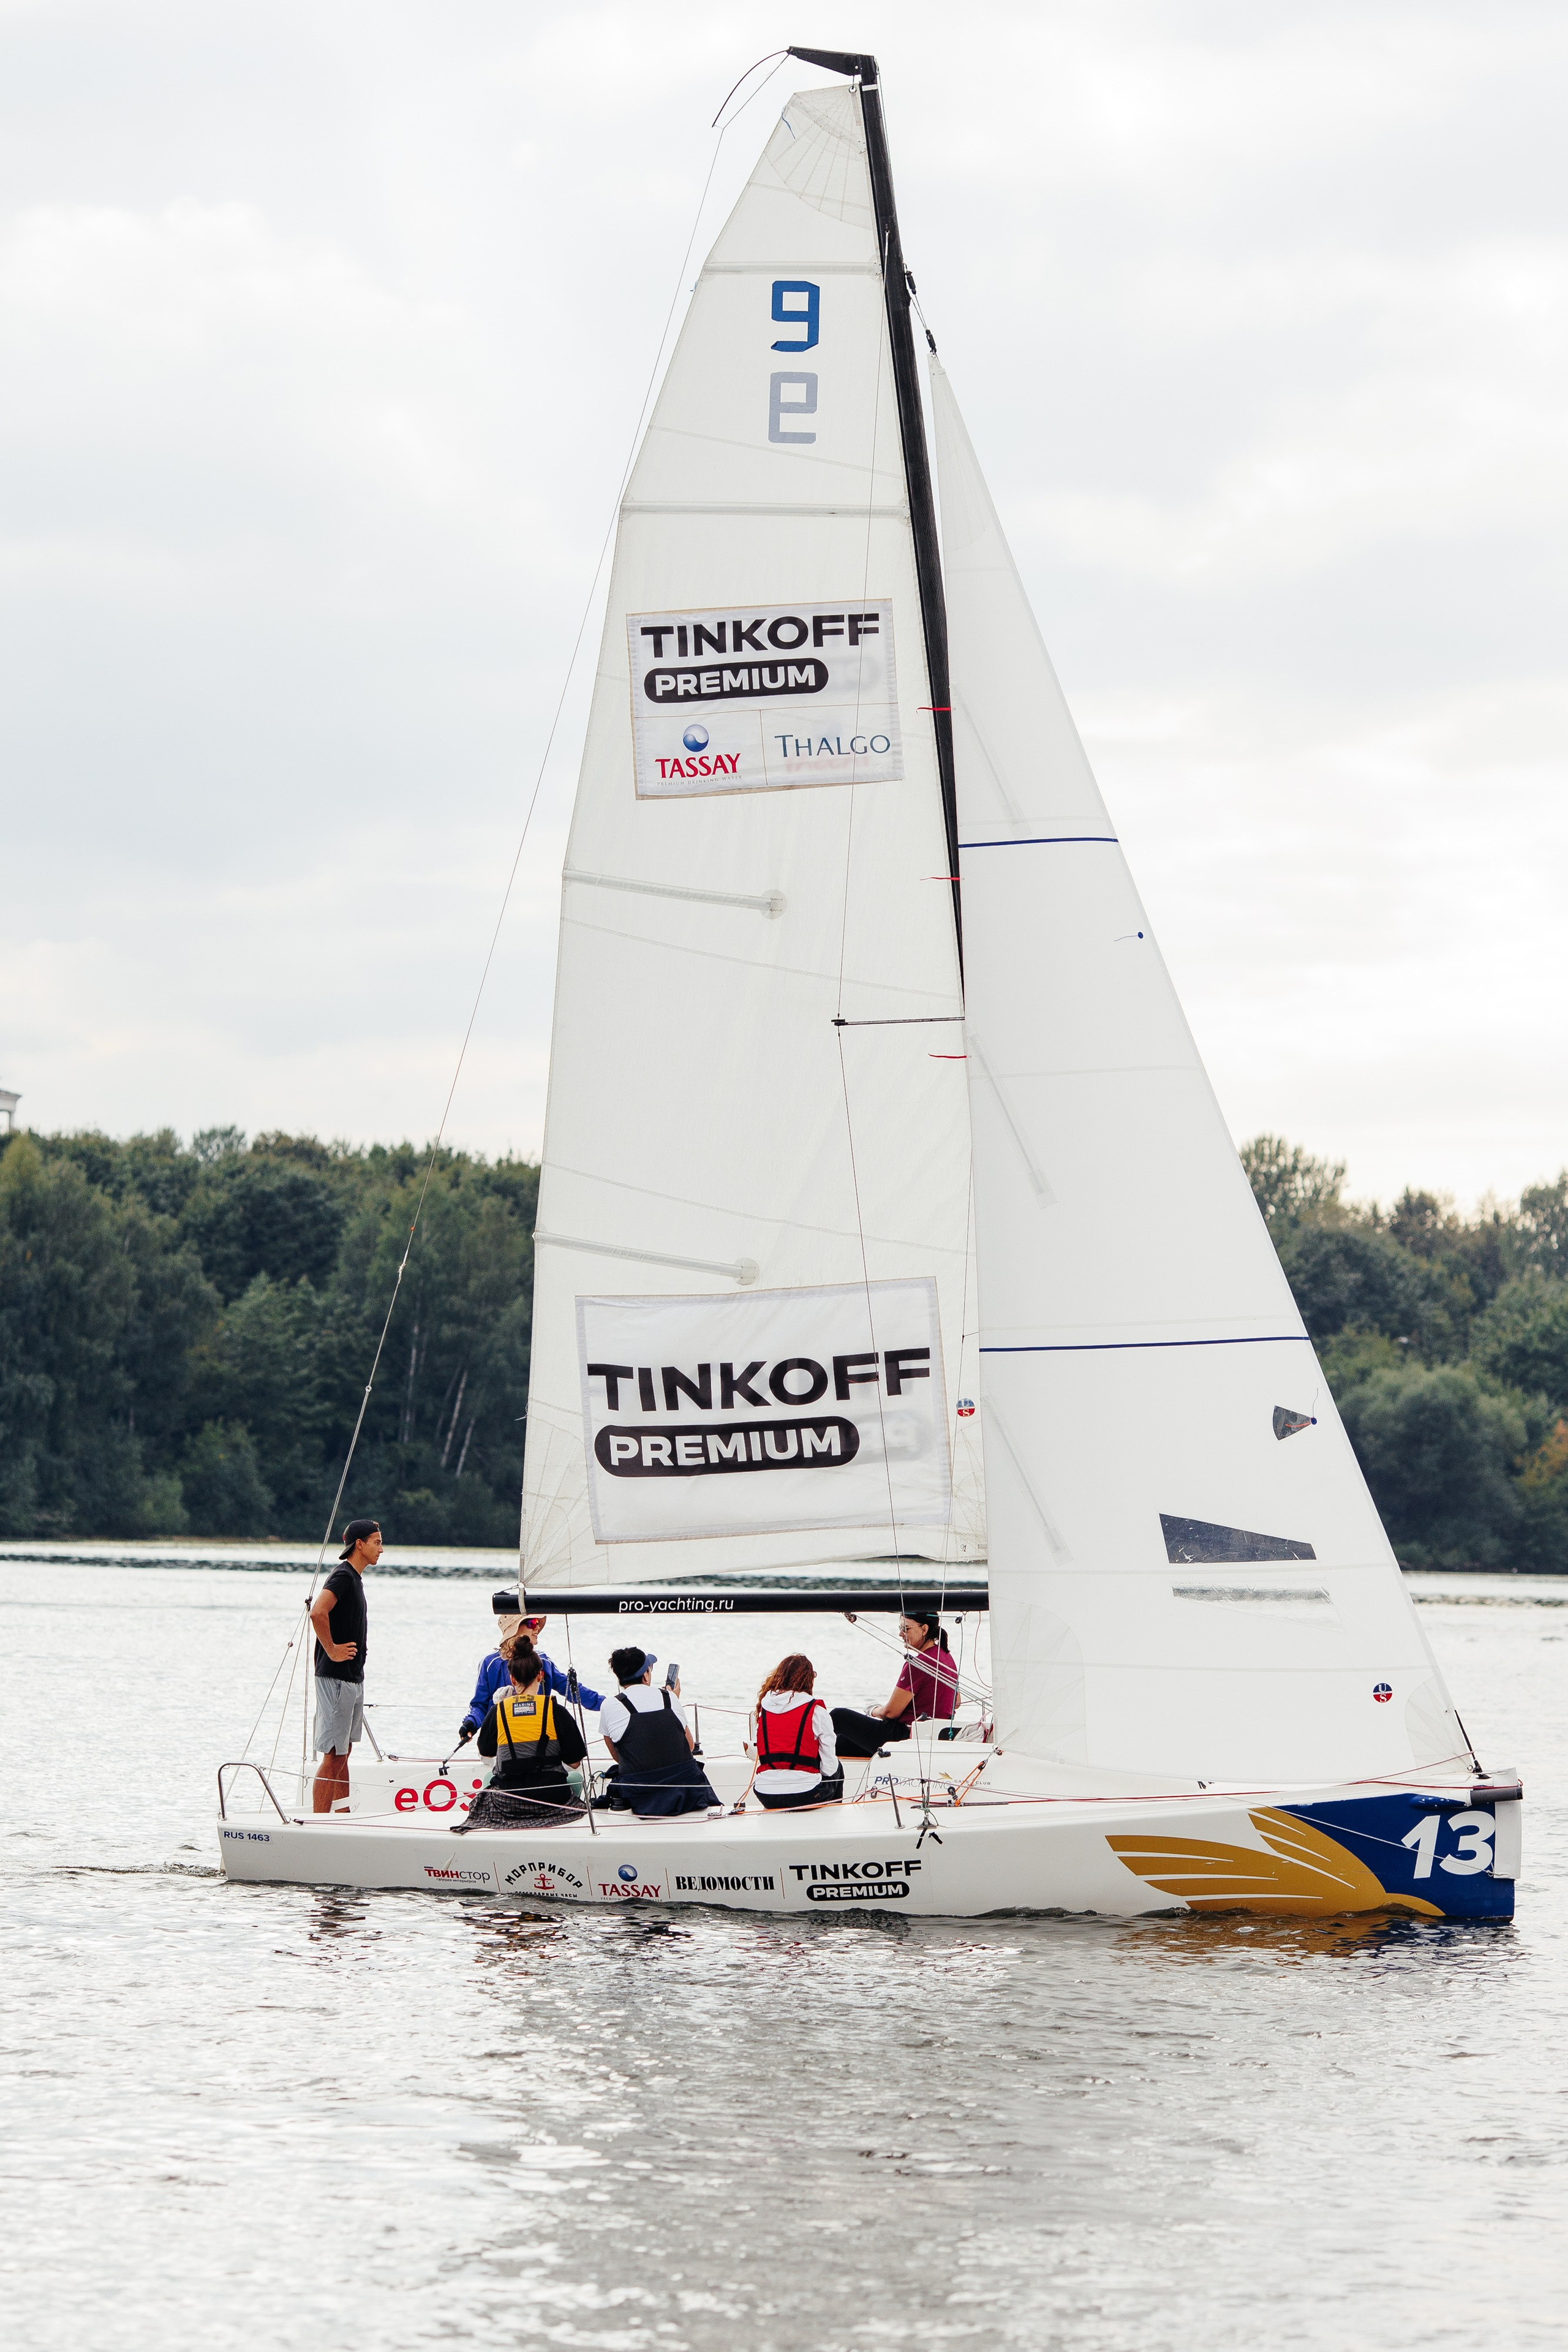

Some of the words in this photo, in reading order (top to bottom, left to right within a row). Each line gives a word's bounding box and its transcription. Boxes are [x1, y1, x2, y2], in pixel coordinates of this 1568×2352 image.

[771, 281, 820, 352] 9
[640, 612, 880, 658] TINKOFF
[655, 665, 816, 696] PREMIUM
[655, 753, 741, 778] TASSAY
[587, 1347, 930, 1411] TINKOFF
[609, 1425, 842, 1466] PREMIUM
[619, 1597, 734, 1613] pro-yachting.ru
[224, 1831, 244, 1839] RUS
[247, 1833, 270, 1842] 1463
[1401, 1811, 1496, 1879] 13
[505, 1862, 583, 1888] МОРПРИБОР
[789, 1860, 922, 1880] TINKOFF
[597, 1883, 662, 1898] TASSAY
[674, 1875, 775, 1892] ВЕДОМОСТИ
[813, 1884, 903, 1898] PREMIUM
